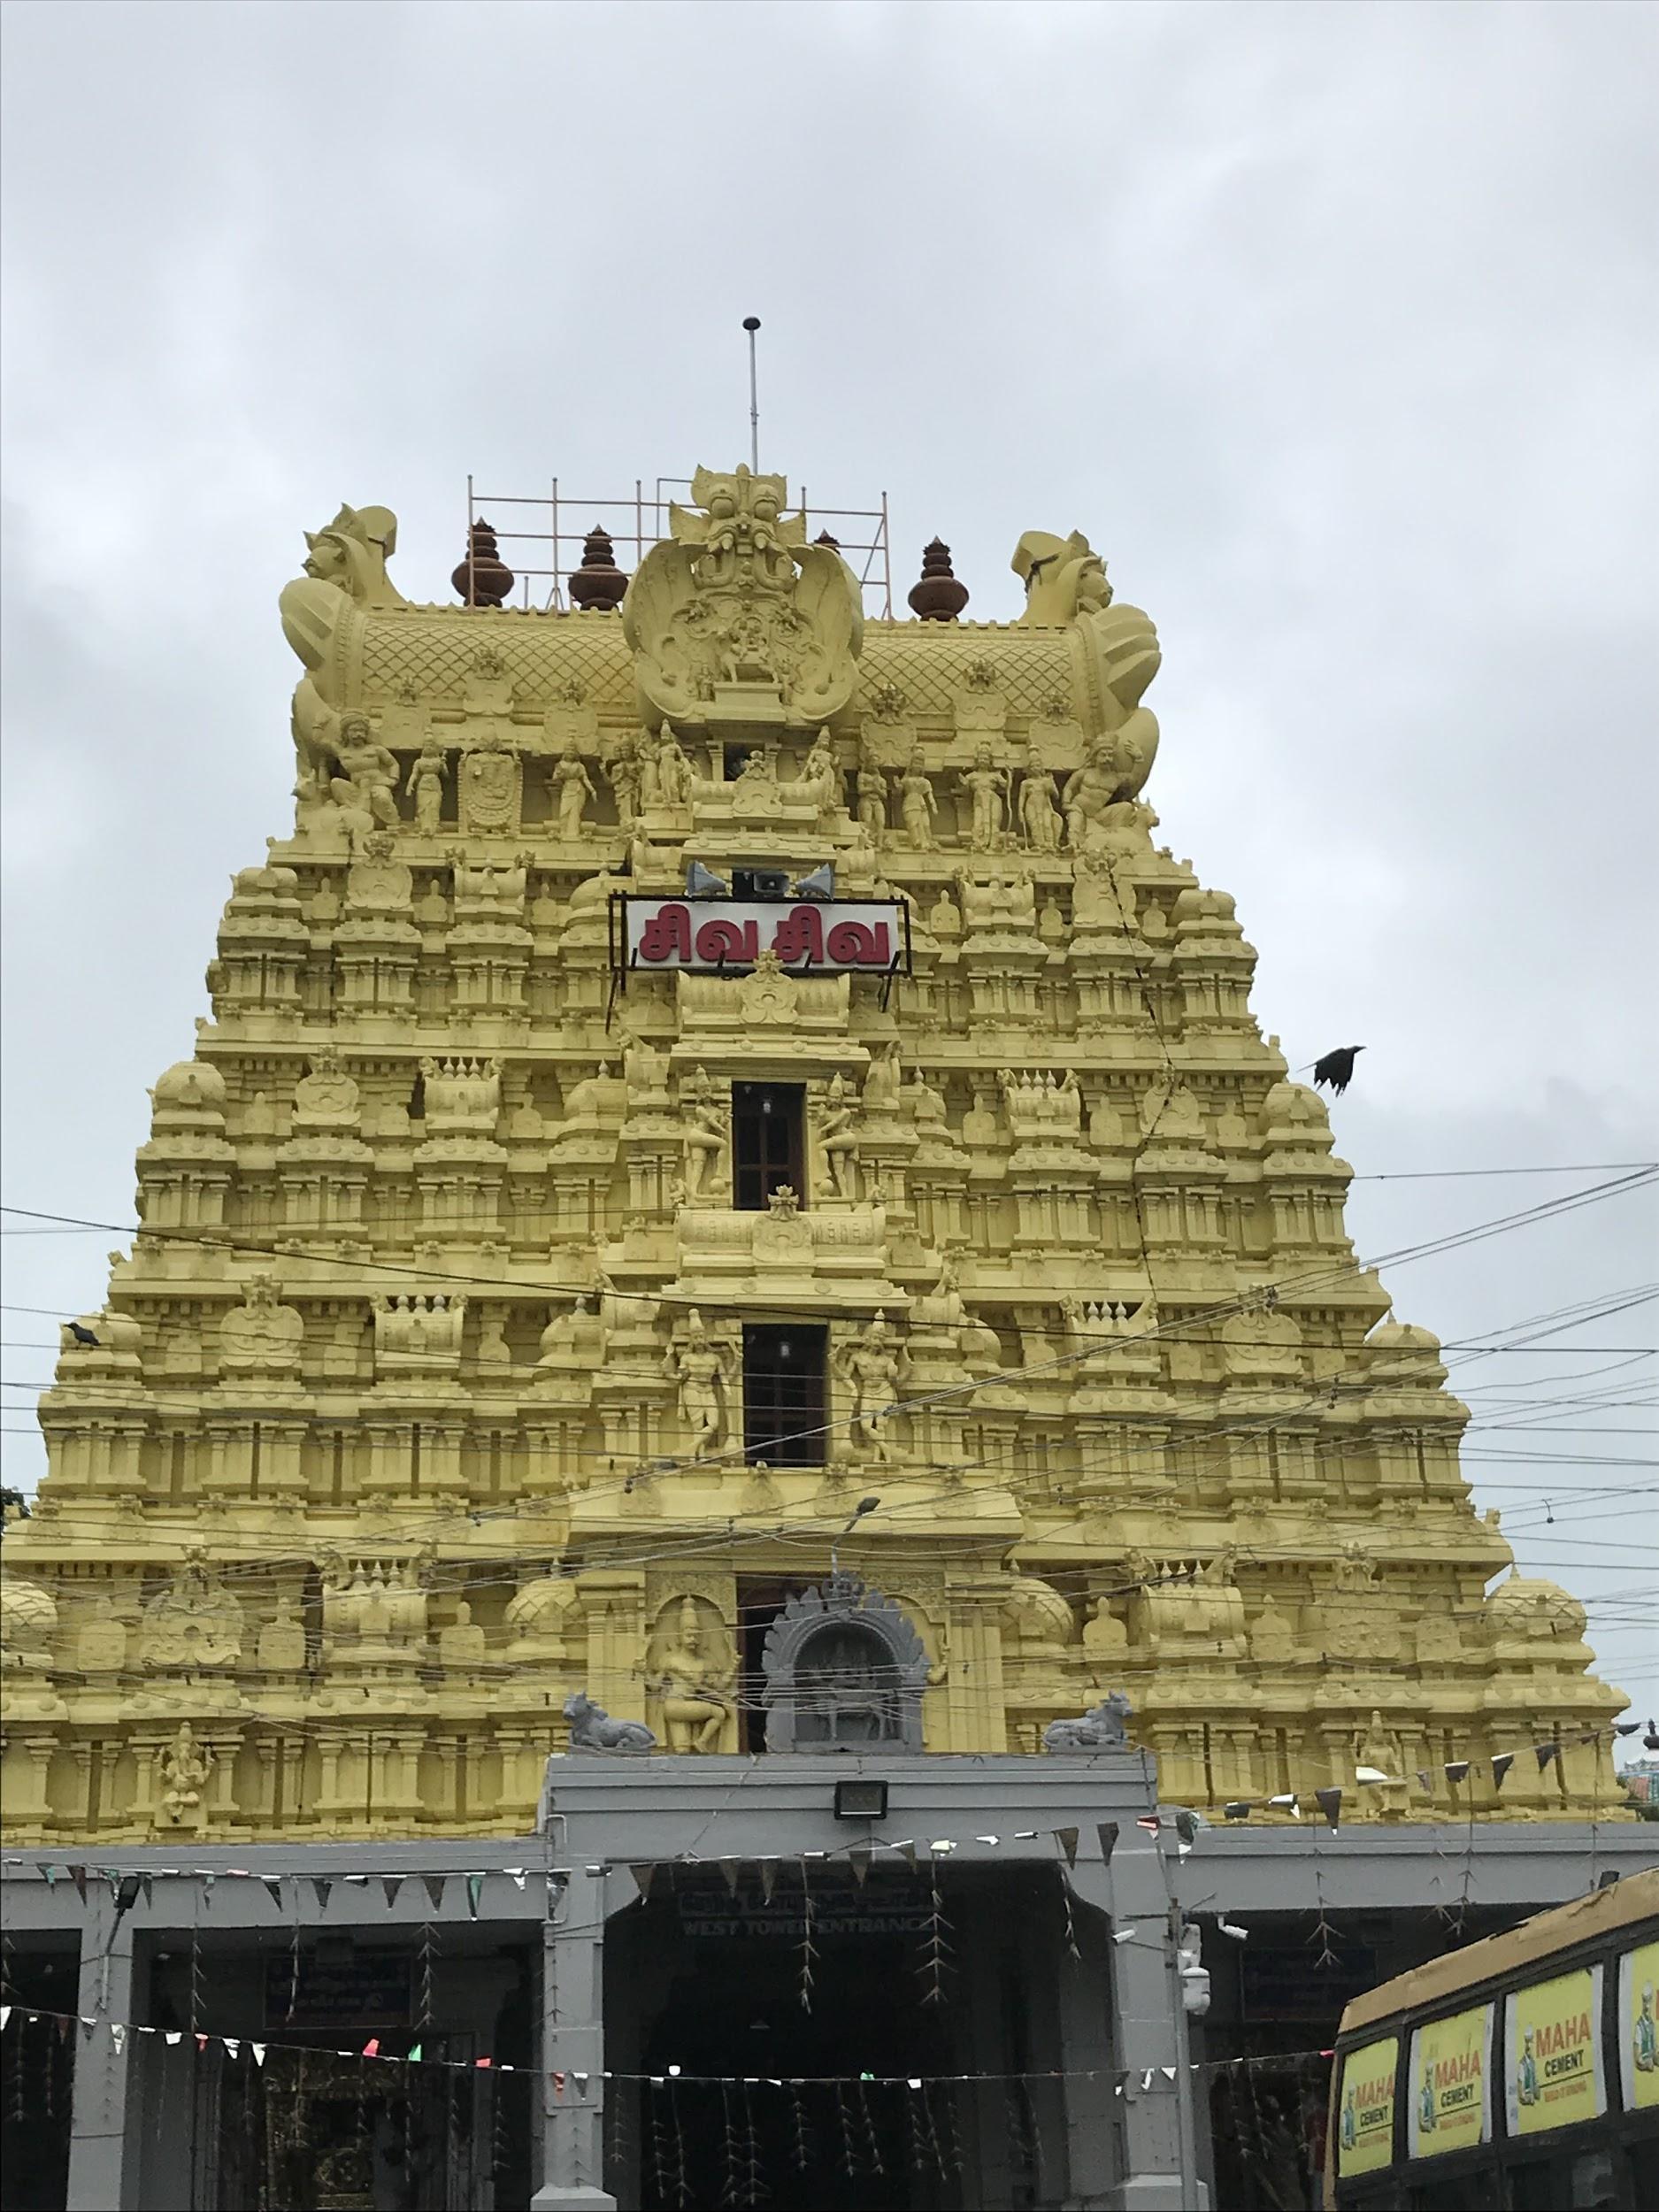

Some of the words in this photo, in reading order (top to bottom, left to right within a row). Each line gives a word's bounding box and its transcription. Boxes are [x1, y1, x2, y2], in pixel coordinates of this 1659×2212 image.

[639, 903, 759, 963] சிவ
[771, 905, 890, 964] சிவ
[683, 1918, 738, 1936] WEST
[1536, 2012, 1592, 2060] MAHA
[1435, 2049, 1481, 2089] MAHA
[1544, 2049, 1585, 2078] CEMENT
[1356, 2072, 1395, 2110] MAHA
[1440, 2083, 1474, 2108] CEMENT
[1360, 2105, 1388, 2127] CEMENT
